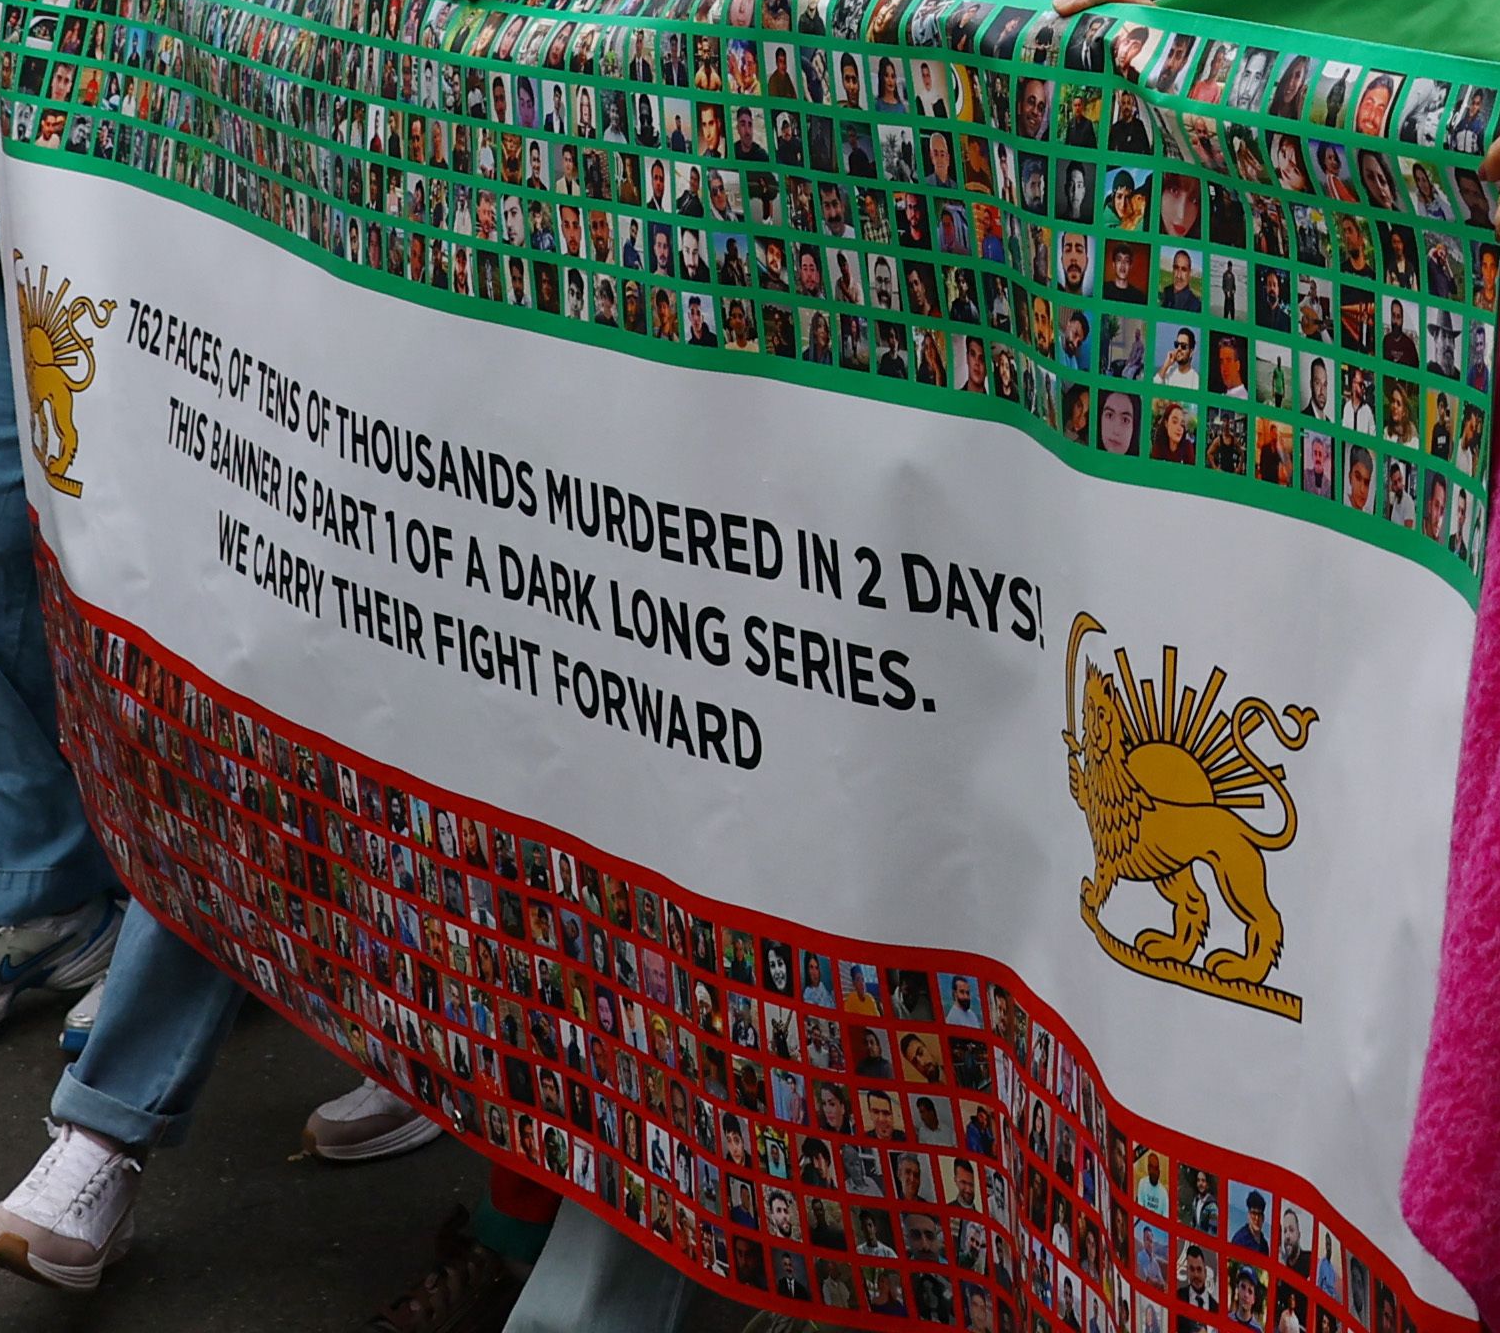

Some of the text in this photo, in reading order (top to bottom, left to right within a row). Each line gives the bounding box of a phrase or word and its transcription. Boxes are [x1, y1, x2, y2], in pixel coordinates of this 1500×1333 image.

[125, 298, 1045, 650] 762 FACES, OF TENS OF THOUSANDS MURDERED IN 2 DAYS!
[169, 395, 936, 713] THIS BANNER IS PART 1 OF A DARK LONG SERIES.
[218, 509, 763, 771] WE CARRY THEIR FIGHT FORWARD
